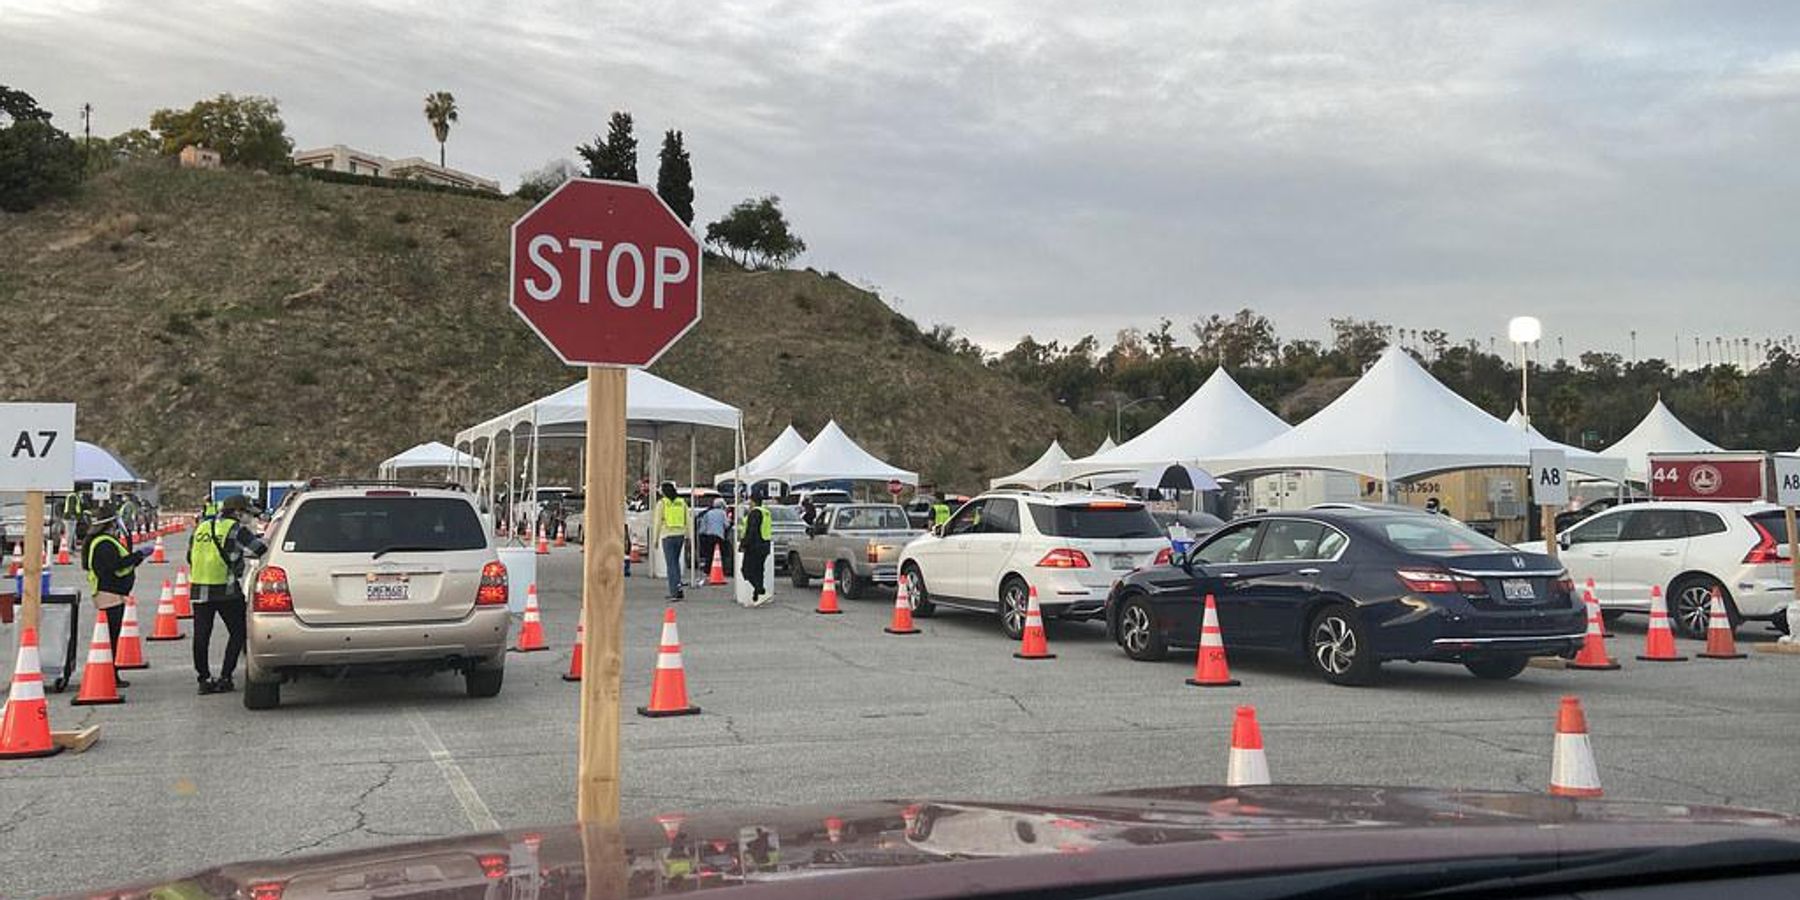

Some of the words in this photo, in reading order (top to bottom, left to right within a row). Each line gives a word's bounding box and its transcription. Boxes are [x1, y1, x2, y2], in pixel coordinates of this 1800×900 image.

[524, 234, 690, 309] STOP
[11, 430, 57, 458] A7
[1540, 467, 1560, 486] A8
[1653, 467, 1679, 483] 44
[1783, 474, 1800, 490] A8
